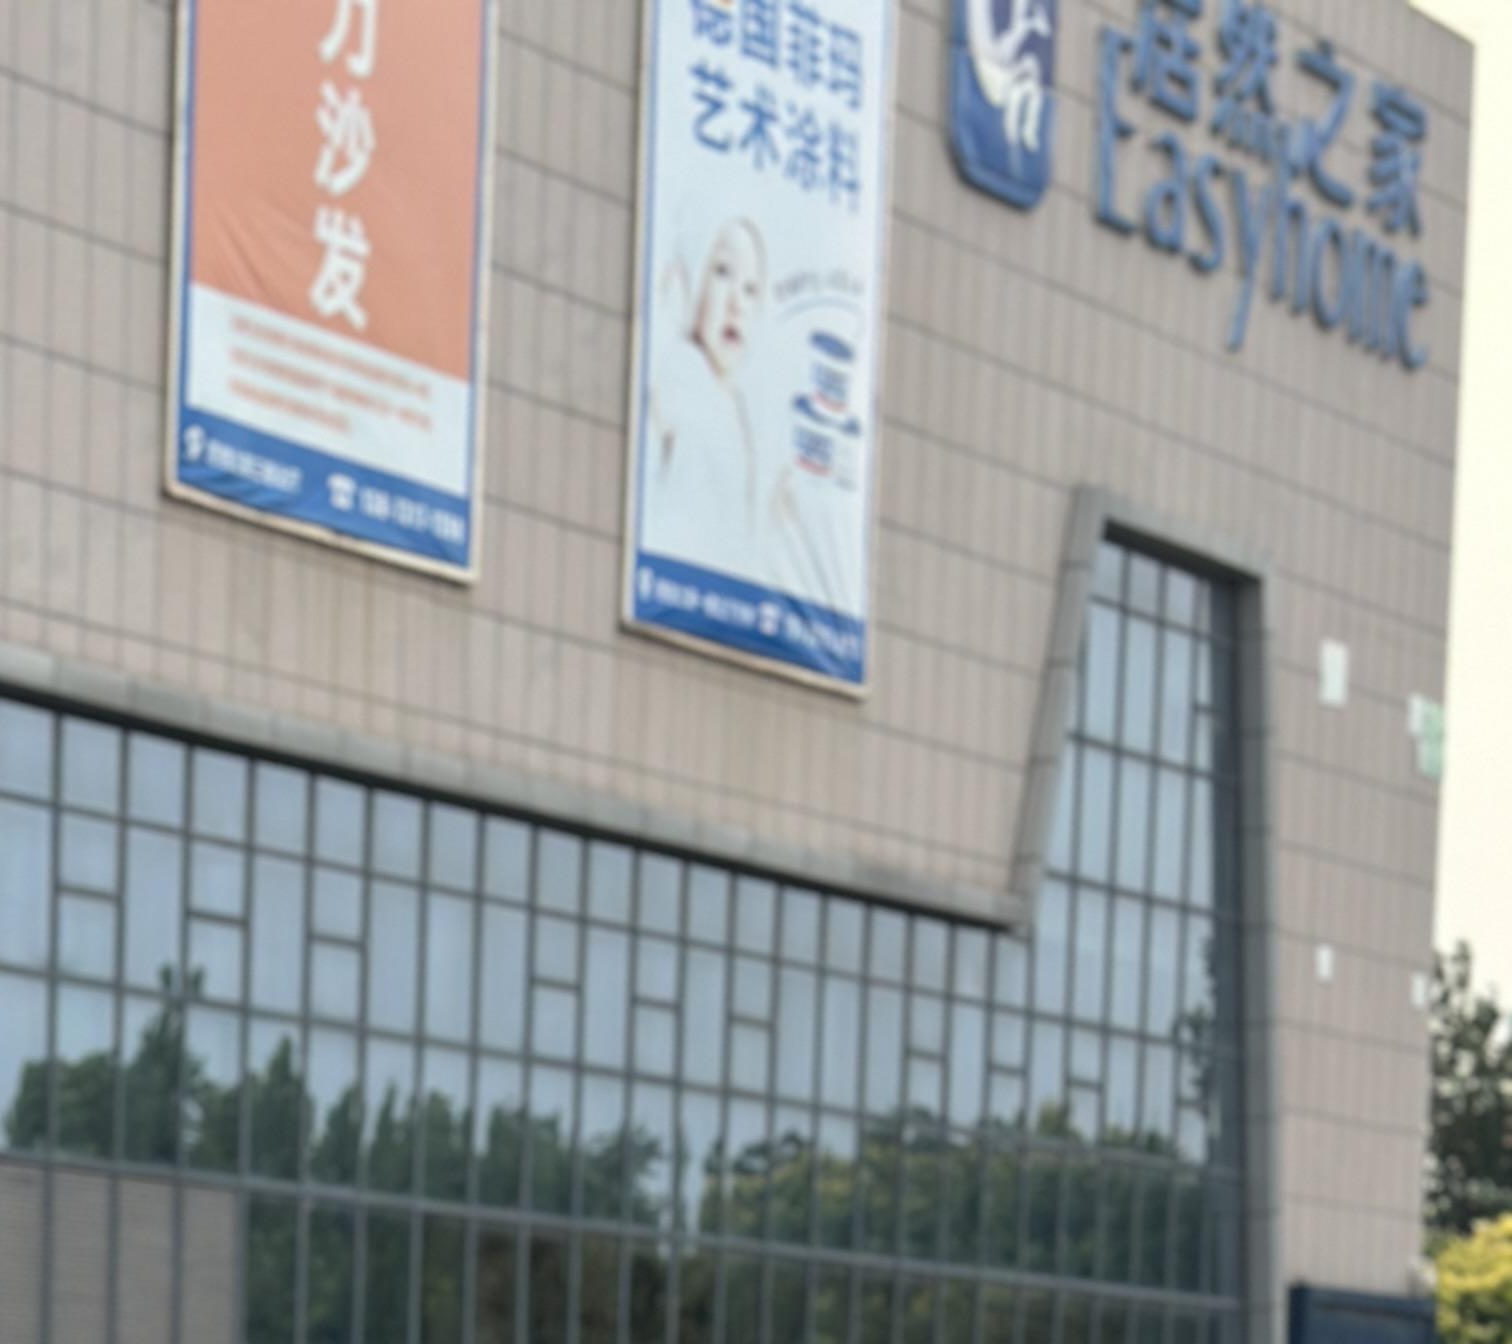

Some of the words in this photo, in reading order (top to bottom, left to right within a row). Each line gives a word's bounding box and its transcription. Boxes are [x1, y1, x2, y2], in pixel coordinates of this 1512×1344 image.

[1096, 26, 1428, 371] Easyhome
[1131, 0, 1425, 240] 居然之家
